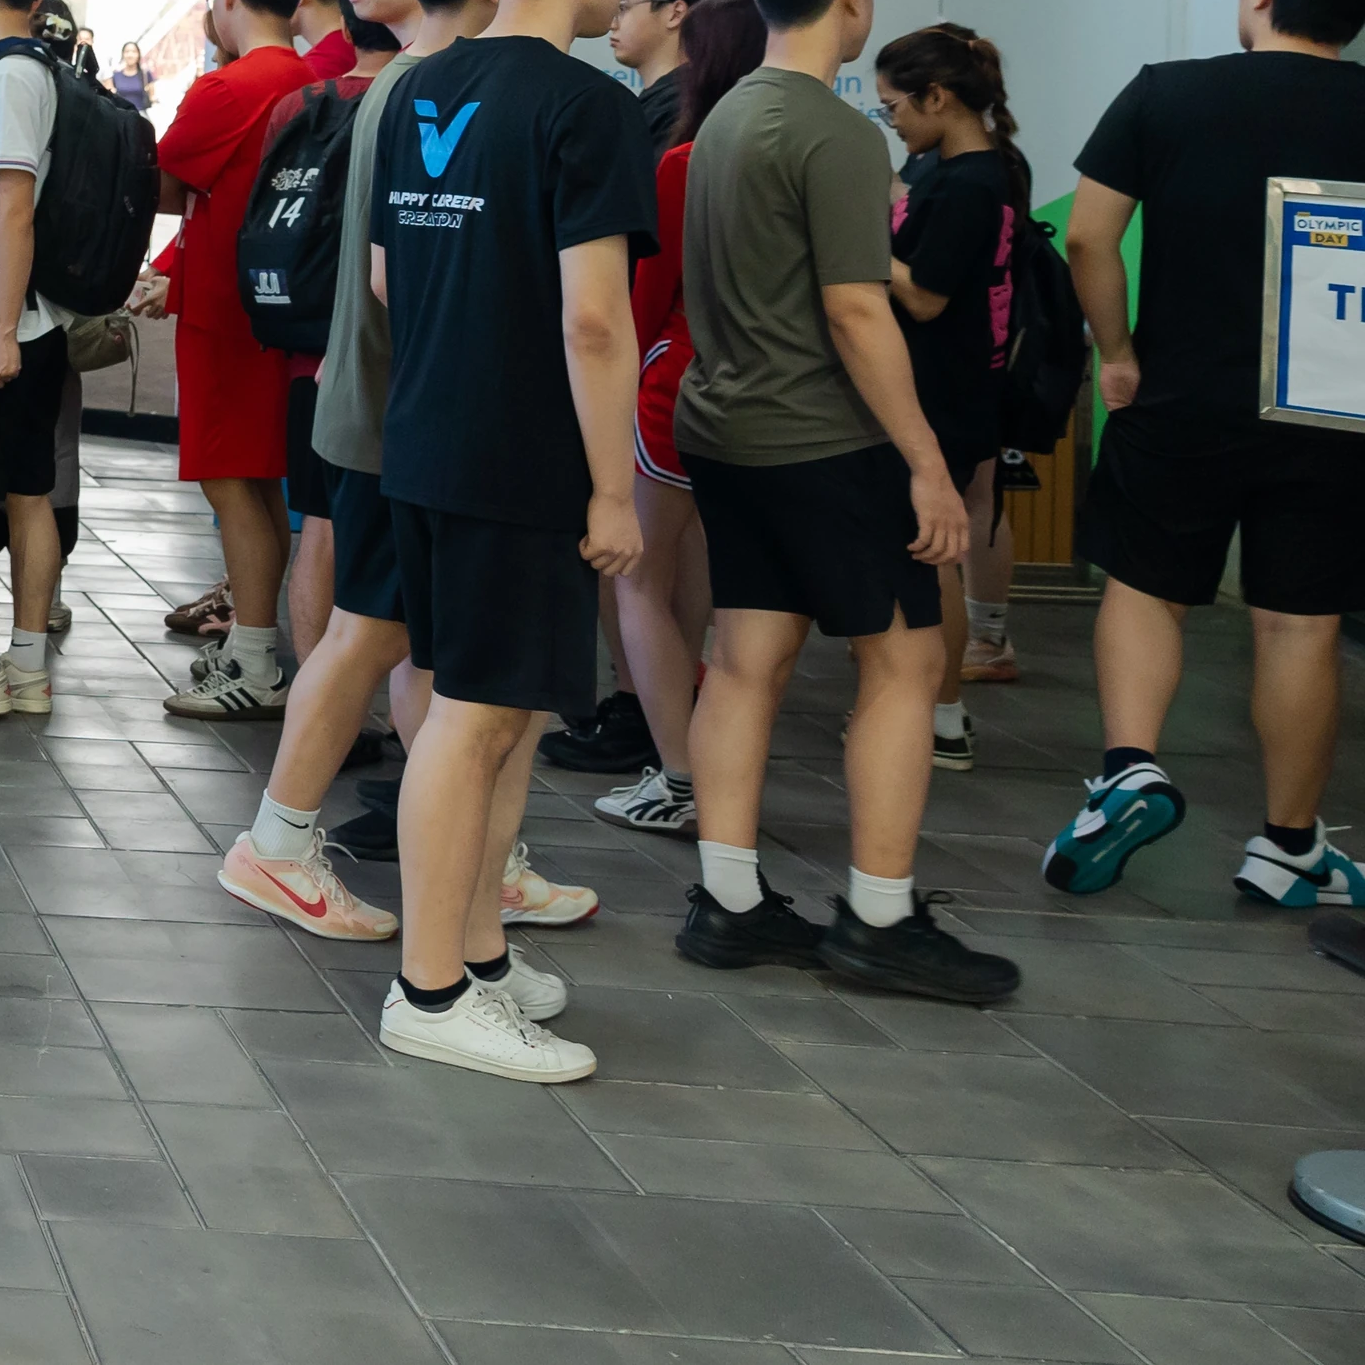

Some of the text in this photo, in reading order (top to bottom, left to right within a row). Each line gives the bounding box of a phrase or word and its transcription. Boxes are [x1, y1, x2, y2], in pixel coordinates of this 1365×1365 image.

[268, 197, 306, 229] 14
[1297, 219, 1361, 232] OLYMPIC
[1315, 233, 1346, 244] DAY
[1327, 283, 1365, 323] T
